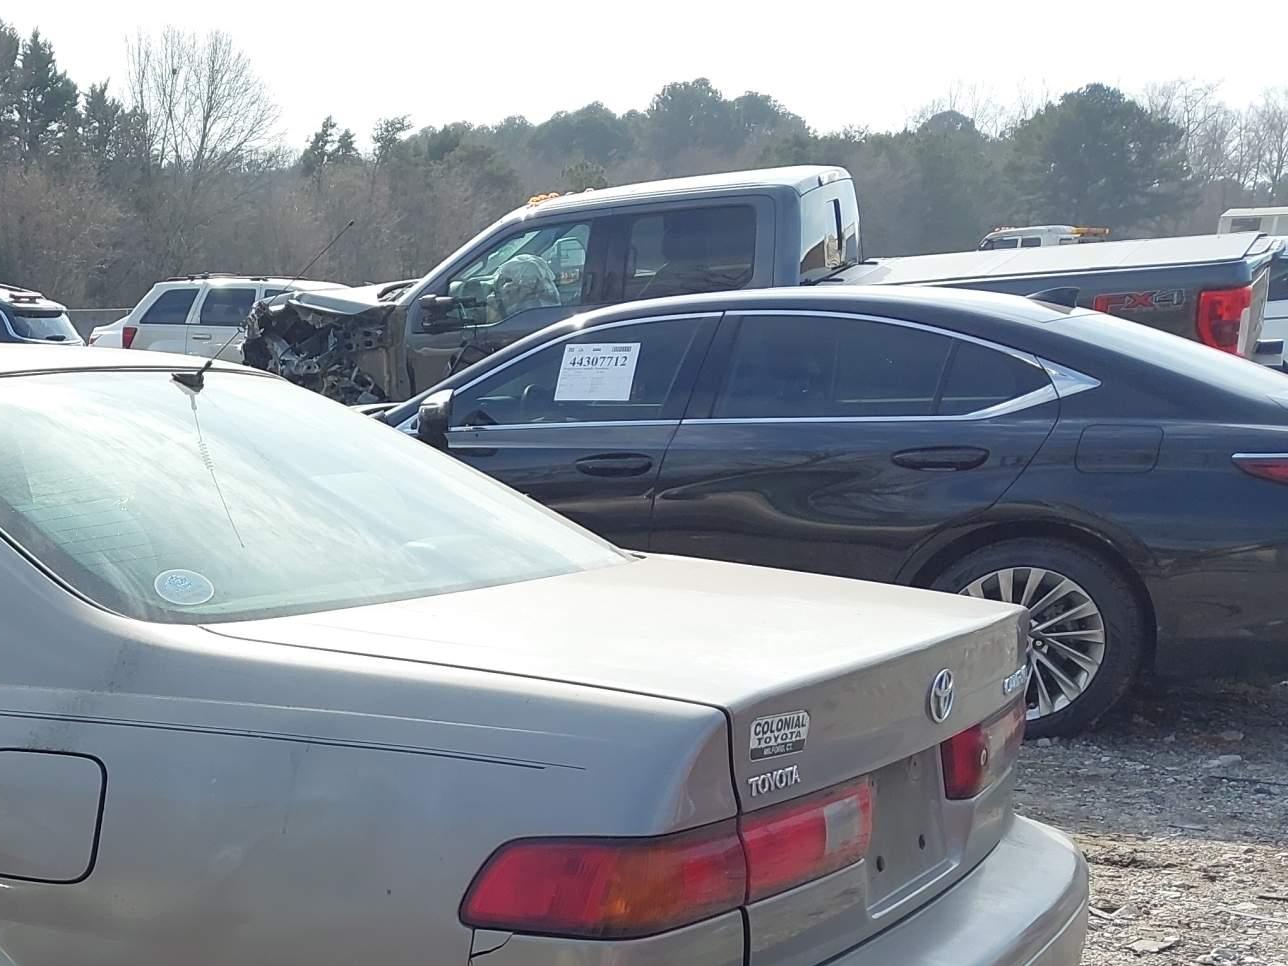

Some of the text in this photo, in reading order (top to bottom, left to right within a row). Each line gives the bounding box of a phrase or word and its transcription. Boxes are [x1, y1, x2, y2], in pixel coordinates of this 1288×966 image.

[1094, 289, 1184, 313] FX4
[570, 356, 628, 367] 44307712
[754, 715, 807, 737] COLONIAL
[756, 730, 802, 746] TOYOTA
[748, 765, 801, 797] TOYOTA
